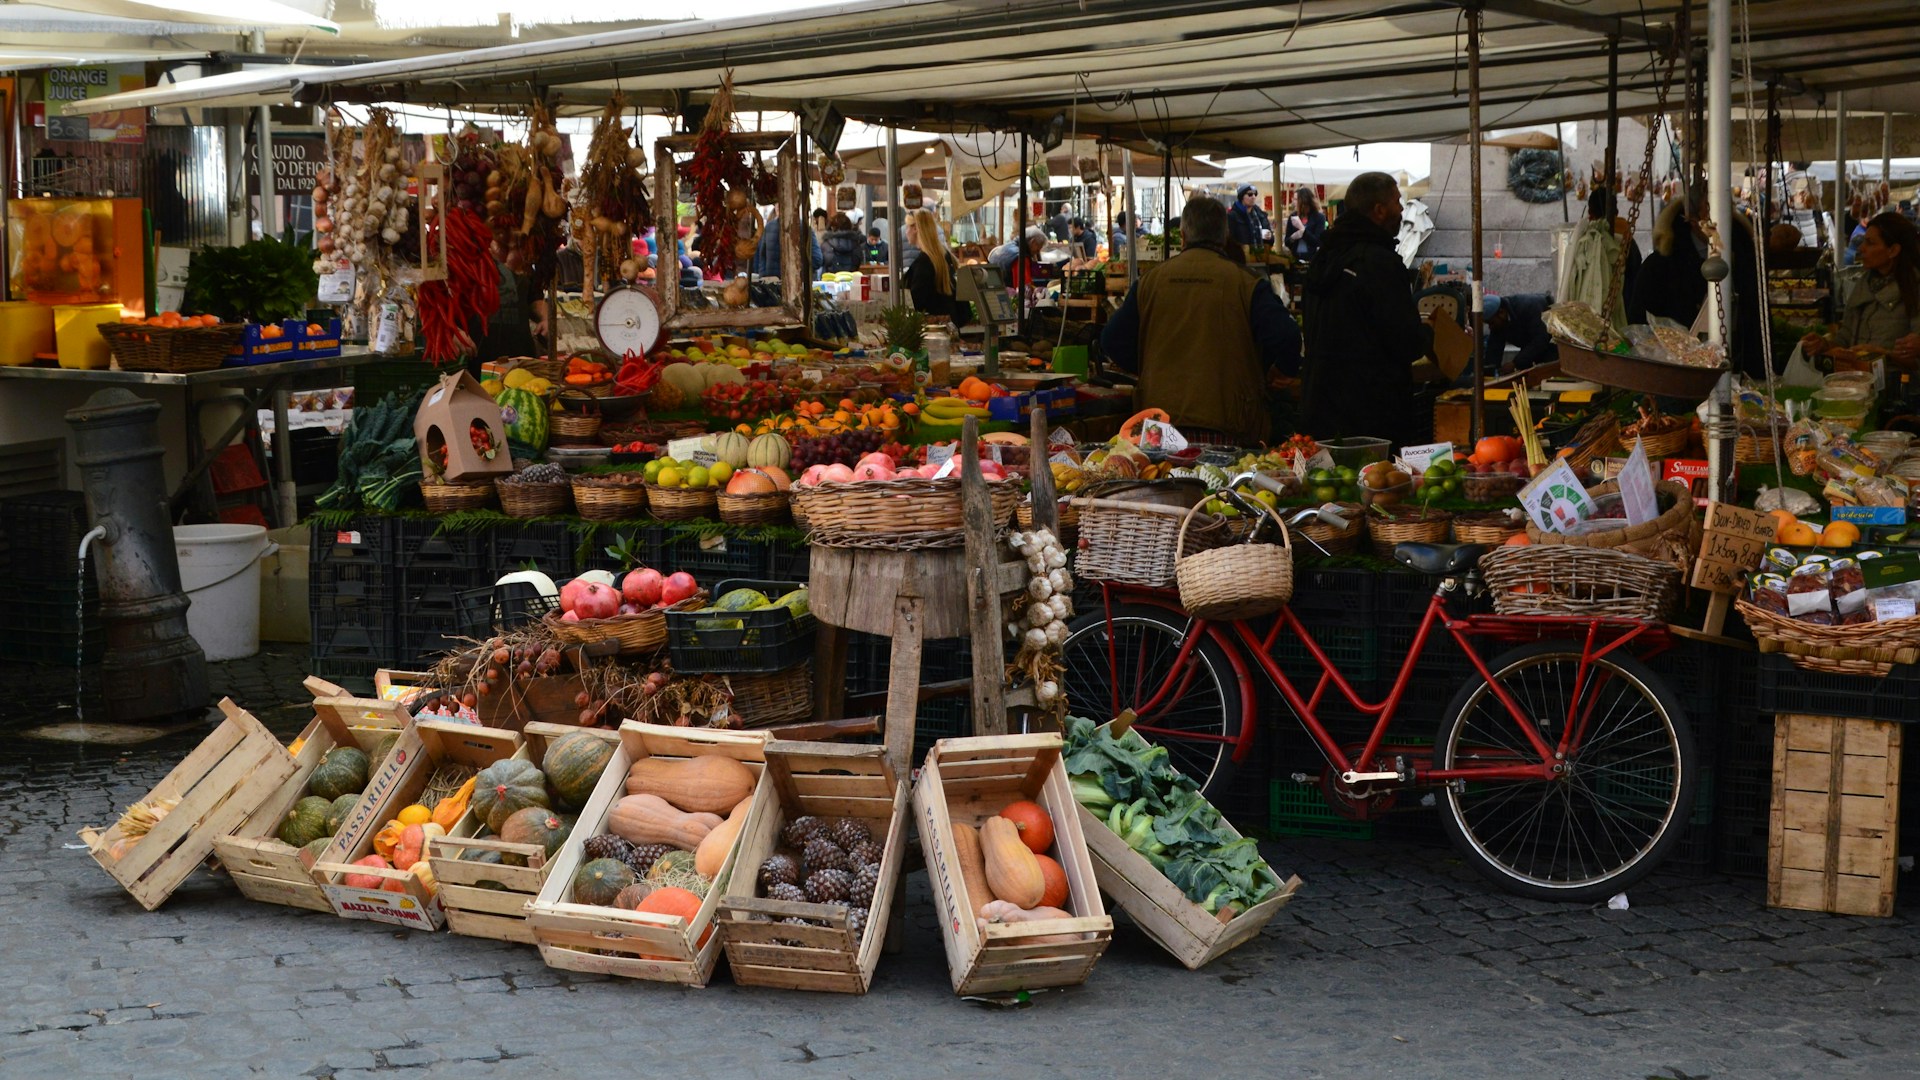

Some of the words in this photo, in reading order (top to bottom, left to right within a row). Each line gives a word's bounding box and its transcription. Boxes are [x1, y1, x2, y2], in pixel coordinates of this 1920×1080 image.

[49, 68, 107, 85] ORANGE
[48, 86, 87, 100] JUICE
[251, 145, 306, 160] CUDIO
[277, 178, 297, 190] DAL
[298, 178, 316, 190] 1929
[1403, 448, 1435, 457] Avocado
[1752, 513, 1775, 539] TOMATO
[340, 901, 377, 914] MAZZA
[376, 906, 422, 921] GIOVANNI
